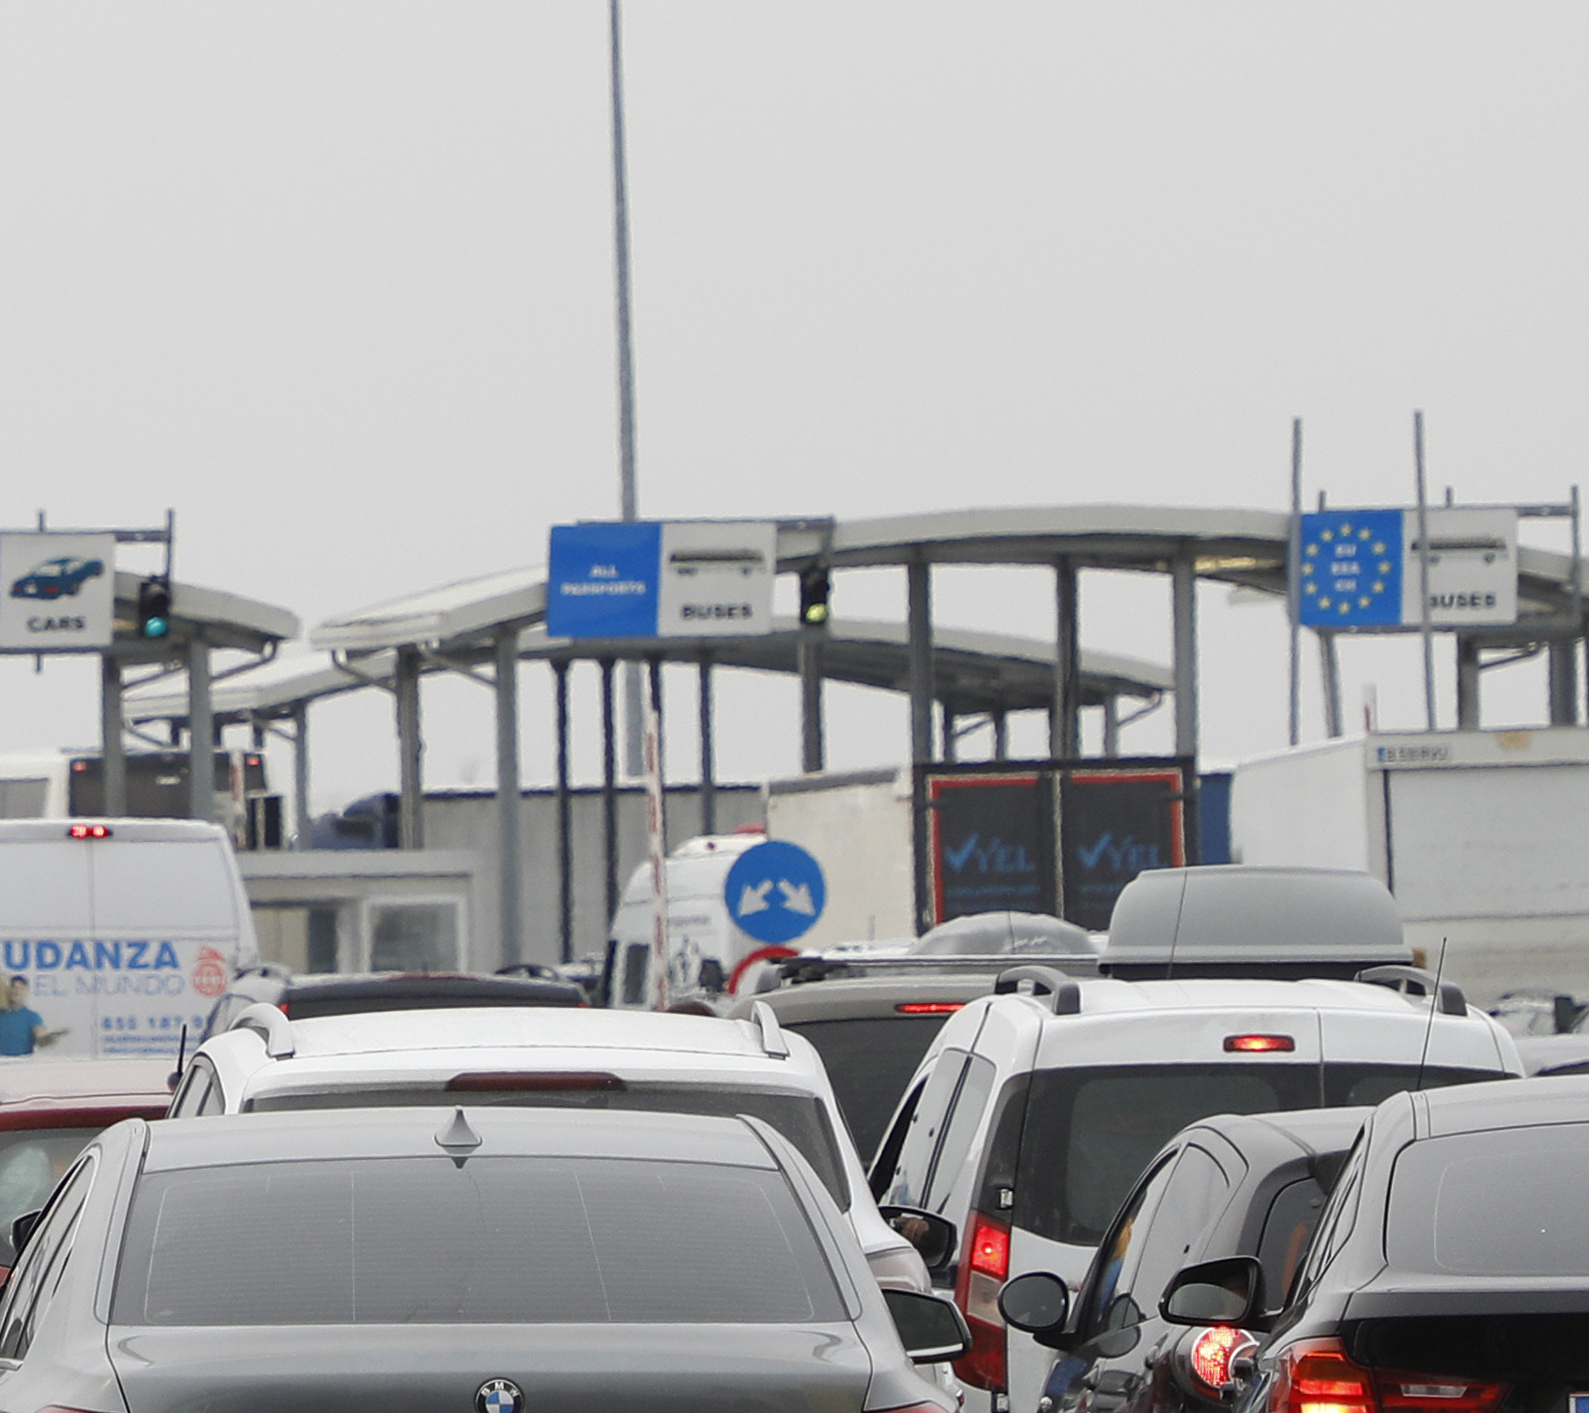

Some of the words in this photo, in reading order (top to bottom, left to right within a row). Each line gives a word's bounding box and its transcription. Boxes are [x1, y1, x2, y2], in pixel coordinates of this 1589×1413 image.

[681, 604, 753, 620] BUSES
[26, 616, 85, 632] CARS
[76, 974, 185, 995] MUNDO
